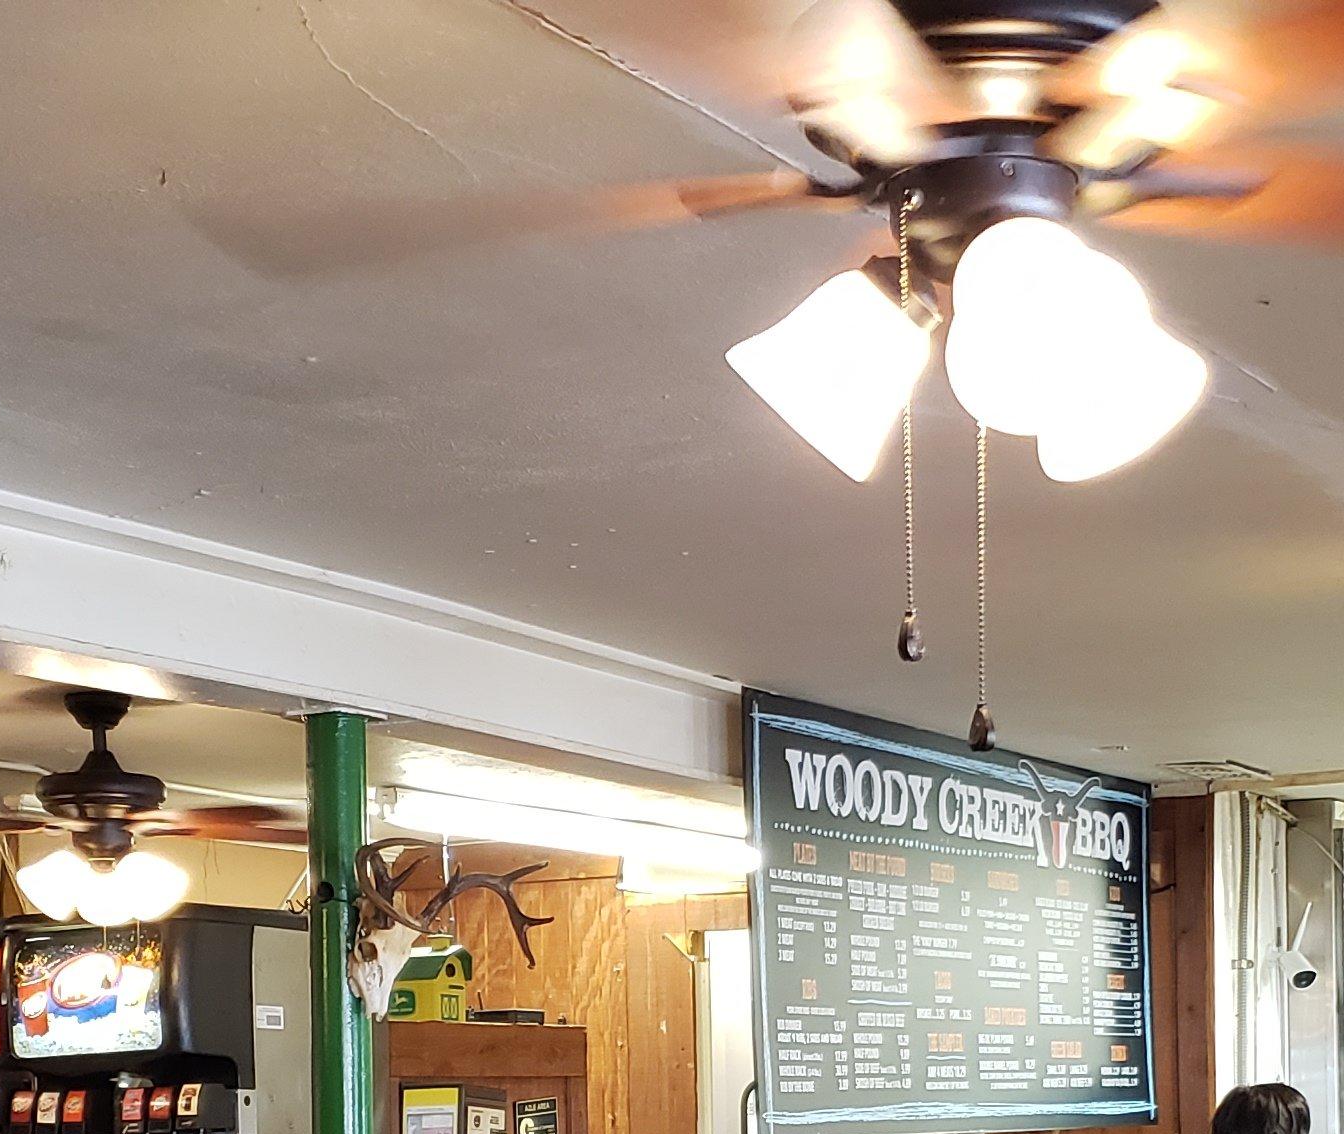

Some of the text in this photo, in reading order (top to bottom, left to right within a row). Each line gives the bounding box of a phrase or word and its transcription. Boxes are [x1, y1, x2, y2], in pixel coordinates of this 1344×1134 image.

[785, 748, 1131, 871] WOODY CREEK BBQ
